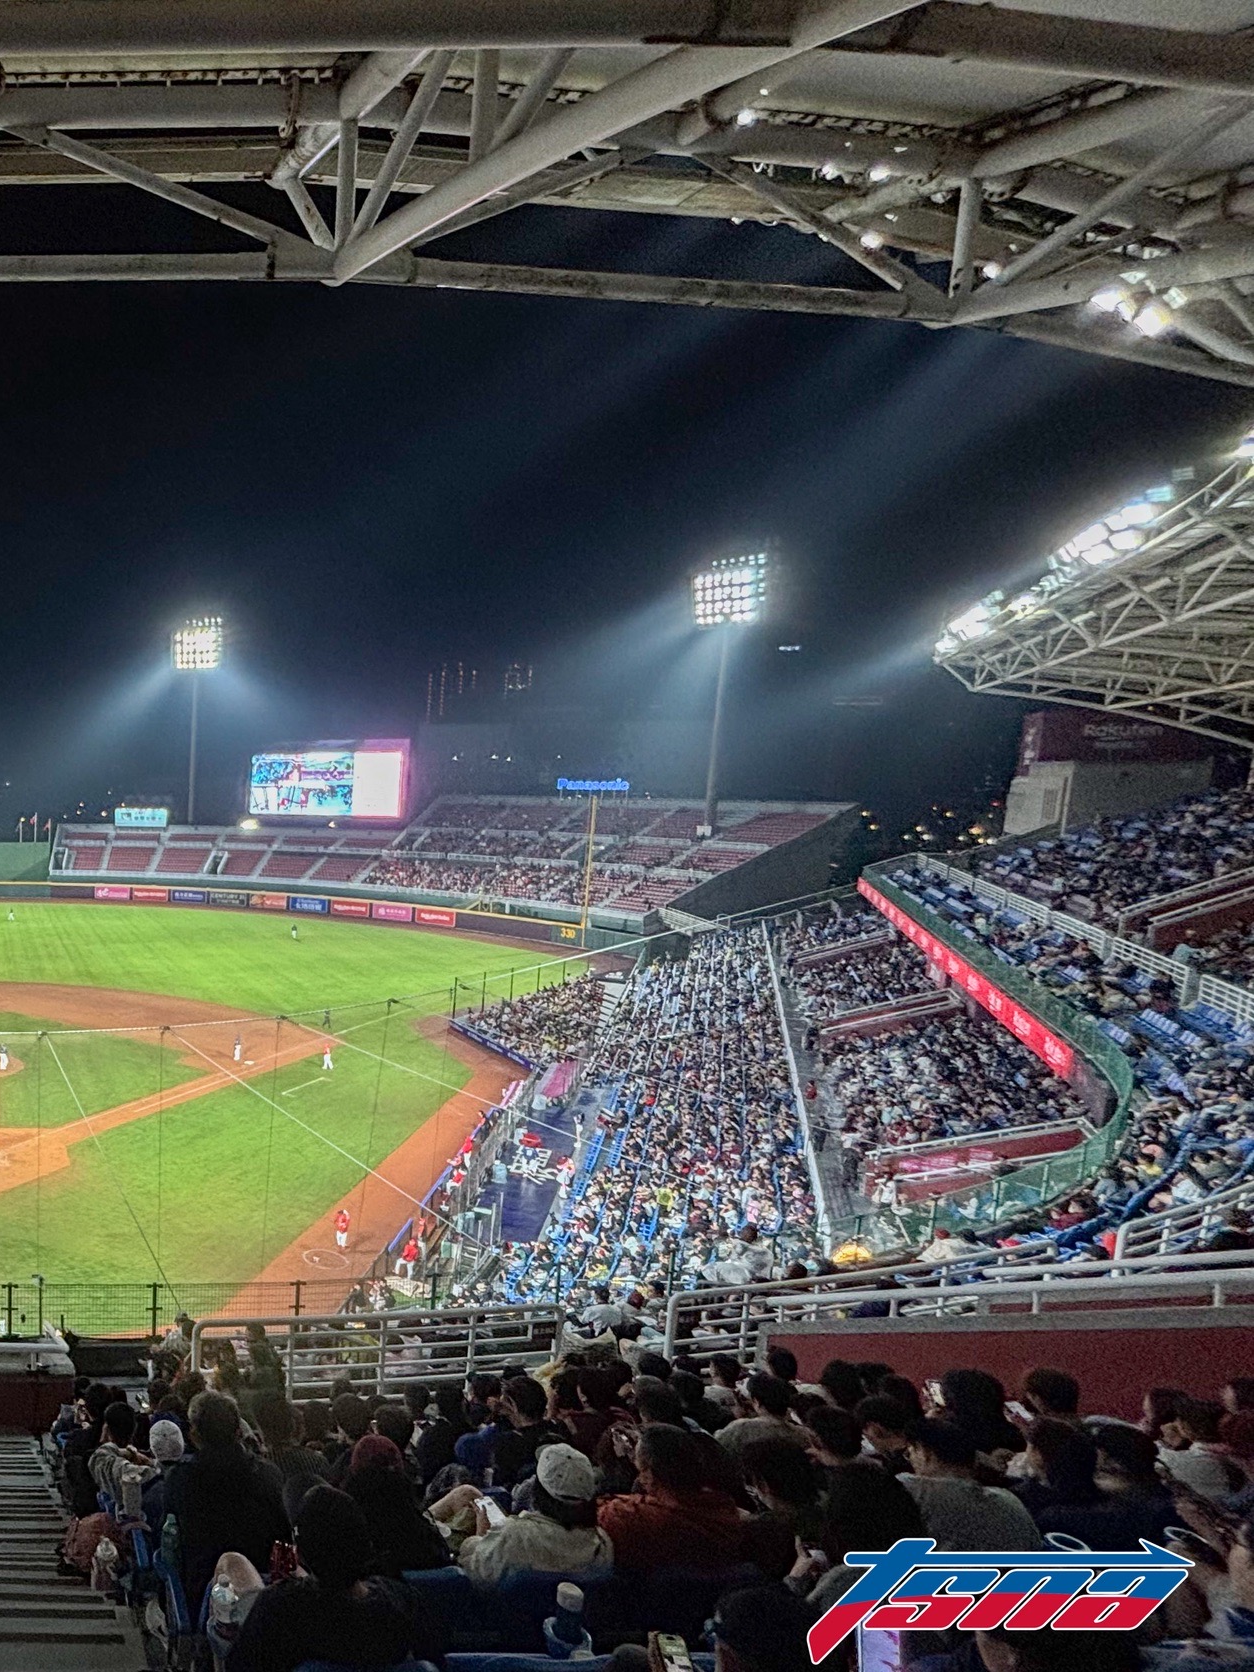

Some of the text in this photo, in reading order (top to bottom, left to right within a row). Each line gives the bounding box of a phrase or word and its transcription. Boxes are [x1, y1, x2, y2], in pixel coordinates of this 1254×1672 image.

[1083, 723, 1164, 738] Rakuten
[557, 778, 629, 790] Panasonic
[560, 927, 576, 939] 330
